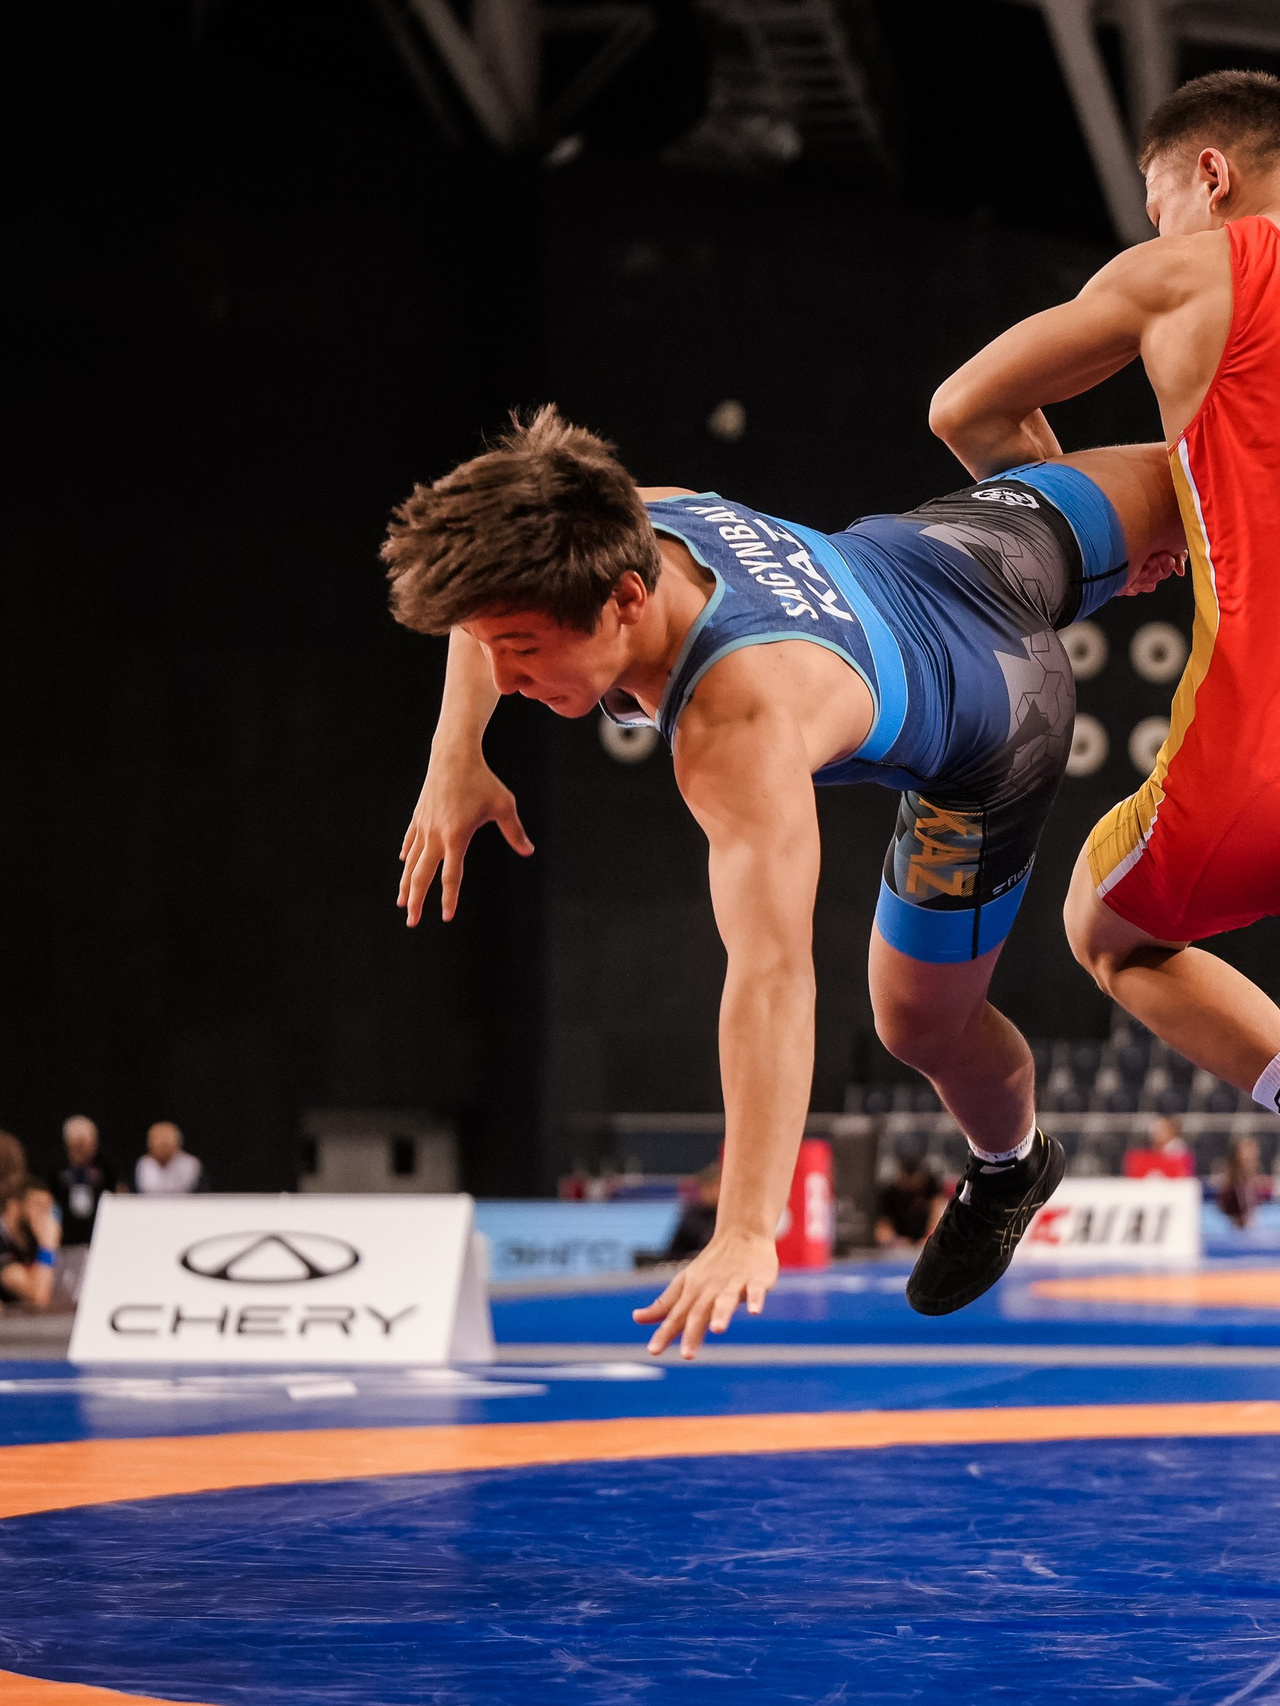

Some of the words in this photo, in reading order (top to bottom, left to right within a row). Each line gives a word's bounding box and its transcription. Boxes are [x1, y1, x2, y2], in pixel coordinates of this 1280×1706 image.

[686, 506, 819, 621] SAGYNBAY
[752, 519, 854, 622] KAZ
[906, 797, 983, 898] KAZ
[109, 1303, 418, 1337] CHERY
